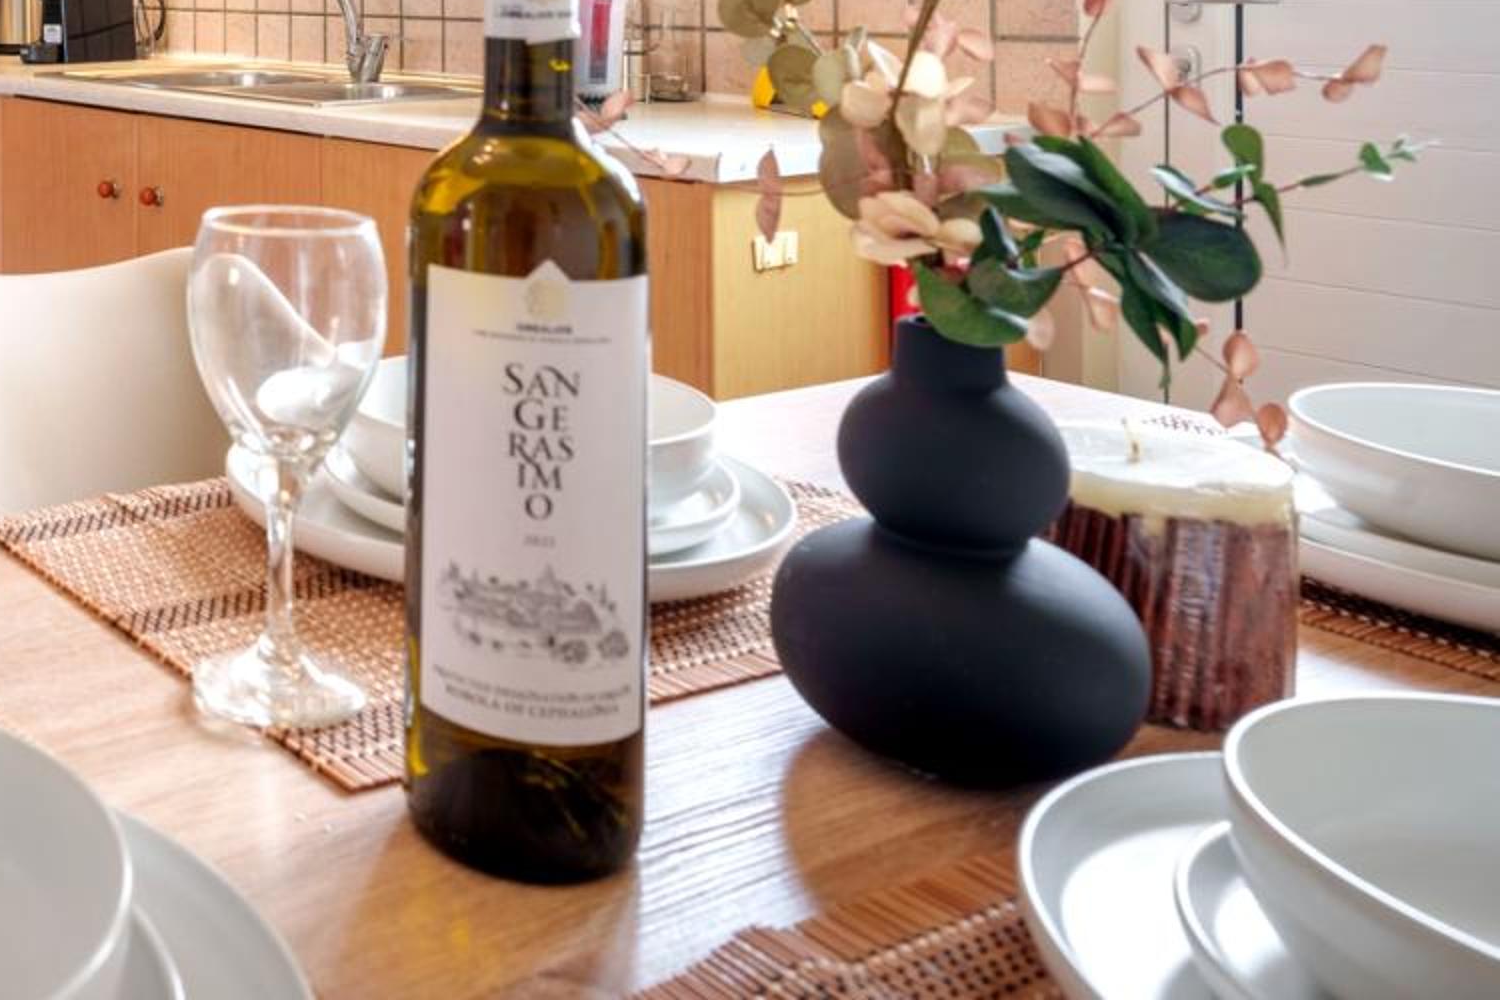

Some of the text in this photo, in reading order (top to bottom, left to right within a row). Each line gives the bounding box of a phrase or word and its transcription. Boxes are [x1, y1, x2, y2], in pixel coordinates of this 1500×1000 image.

[502, 362, 580, 398] SAN
[513, 398, 569, 432] GE
[509, 432, 575, 463] RAS
[524, 493, 553, 521] O
